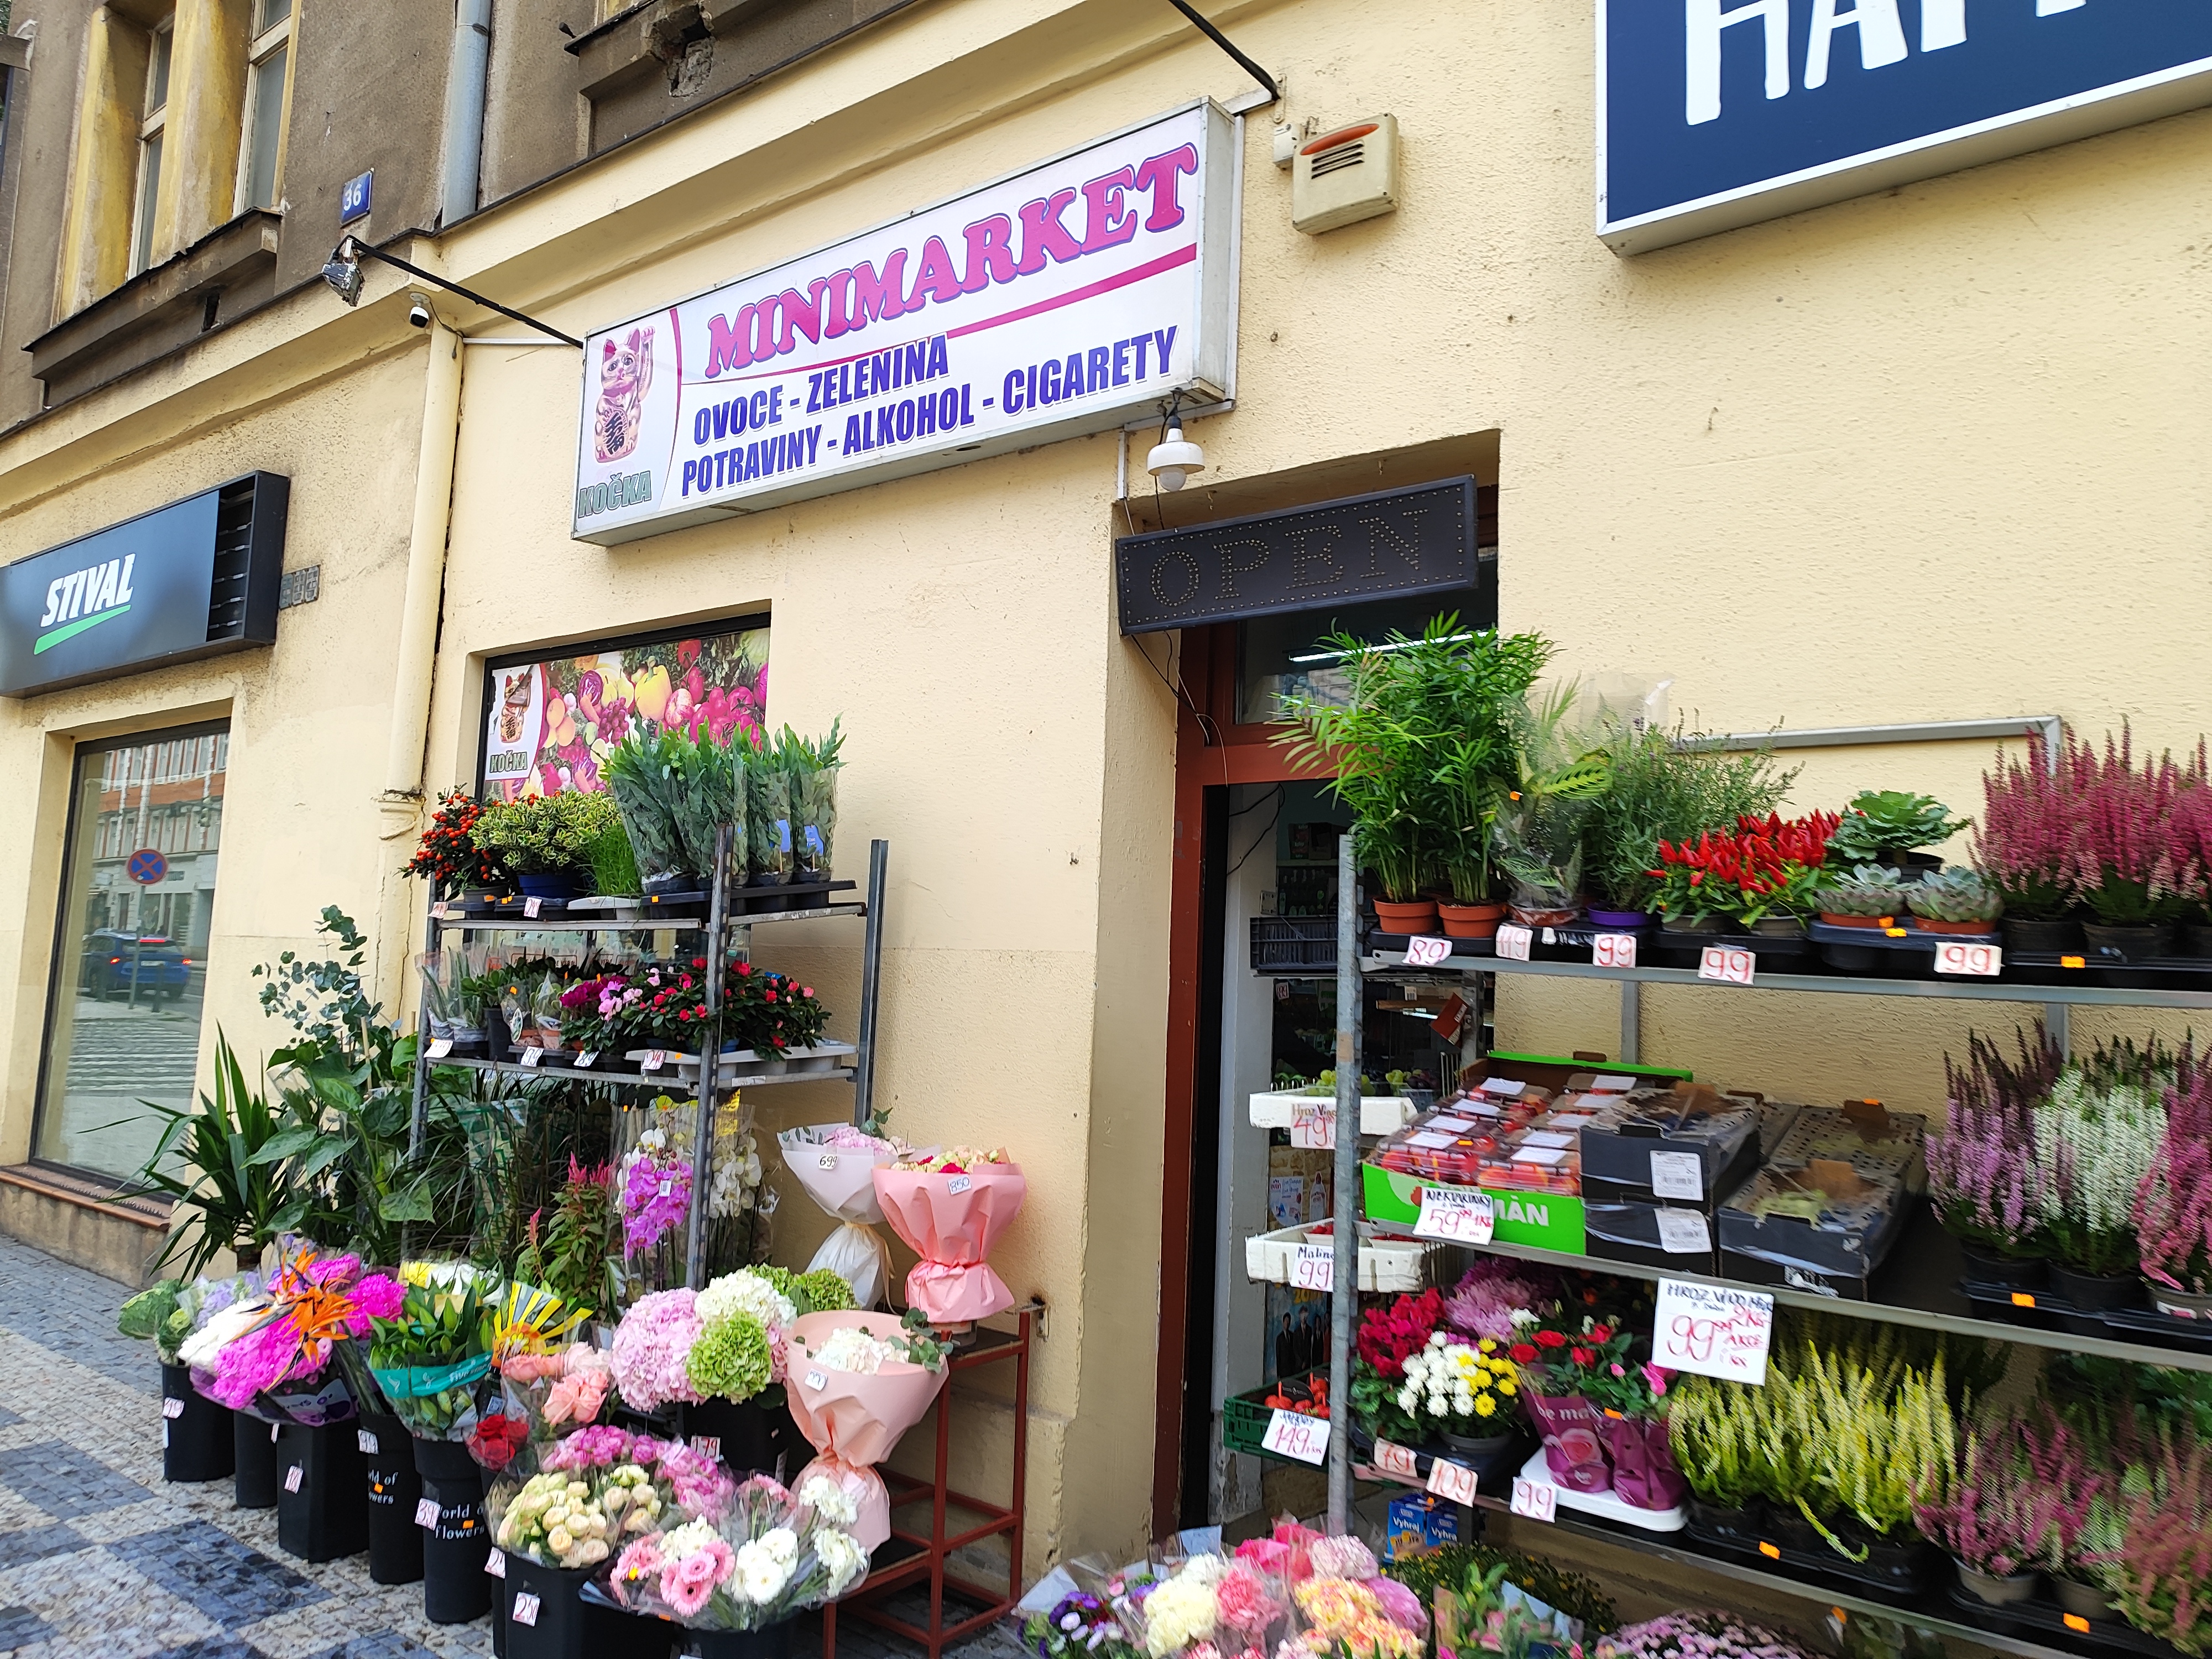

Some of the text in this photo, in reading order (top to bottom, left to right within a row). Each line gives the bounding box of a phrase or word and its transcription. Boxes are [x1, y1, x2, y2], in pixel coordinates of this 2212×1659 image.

[343, 183, 362, 211] 36
[706, 142, 1198, 378] MINIMARKET
[694, 385, 784, 446] OVOCE
[806, 335, 949, 414] ZELENINA
[681, 424, 822, 497] POTRAVINY
[842, 383, 974, 456] ALKOHOL
[1003, 325, 1178, 414] CIGARETY
[578, 471, 652, 519] KOČKA
[1150, 508, 1430, 607] OPEN
[40, 552, 136, 628] STIVAL
[489, 750, 528, 774] KOČKA
[1410, 939, 1445, 965] 89
[1598, 937, 1634, 967] 99
[1705, 950, 1750, 982] 99
[1943, 945, 1992, 973] 99
[524, 1048, 542, 1066] 99
[819, 1154, 838, 1168] 699
[949, 1176, 970, 1192] 850
[1423, 1209, 1460, 1235] 59
[1298, 1260, 1330, 1290] 99
[1666, 1314, 1715, 1362] 99
[692, 1436, 718, 1459] 179
[1274, 1424, 1311, 1456] 149
[384, 1472, 399, 1486] of
[1432, 1464, 1474, 1502] 109
[438, 1503, 470, 1520] orld
[1516, 1481, 1552, 1519] 99
[1392, 1516, 1420, 1533] Vyhraj
[1431, 1526, 1458, 1542] Vyhra
